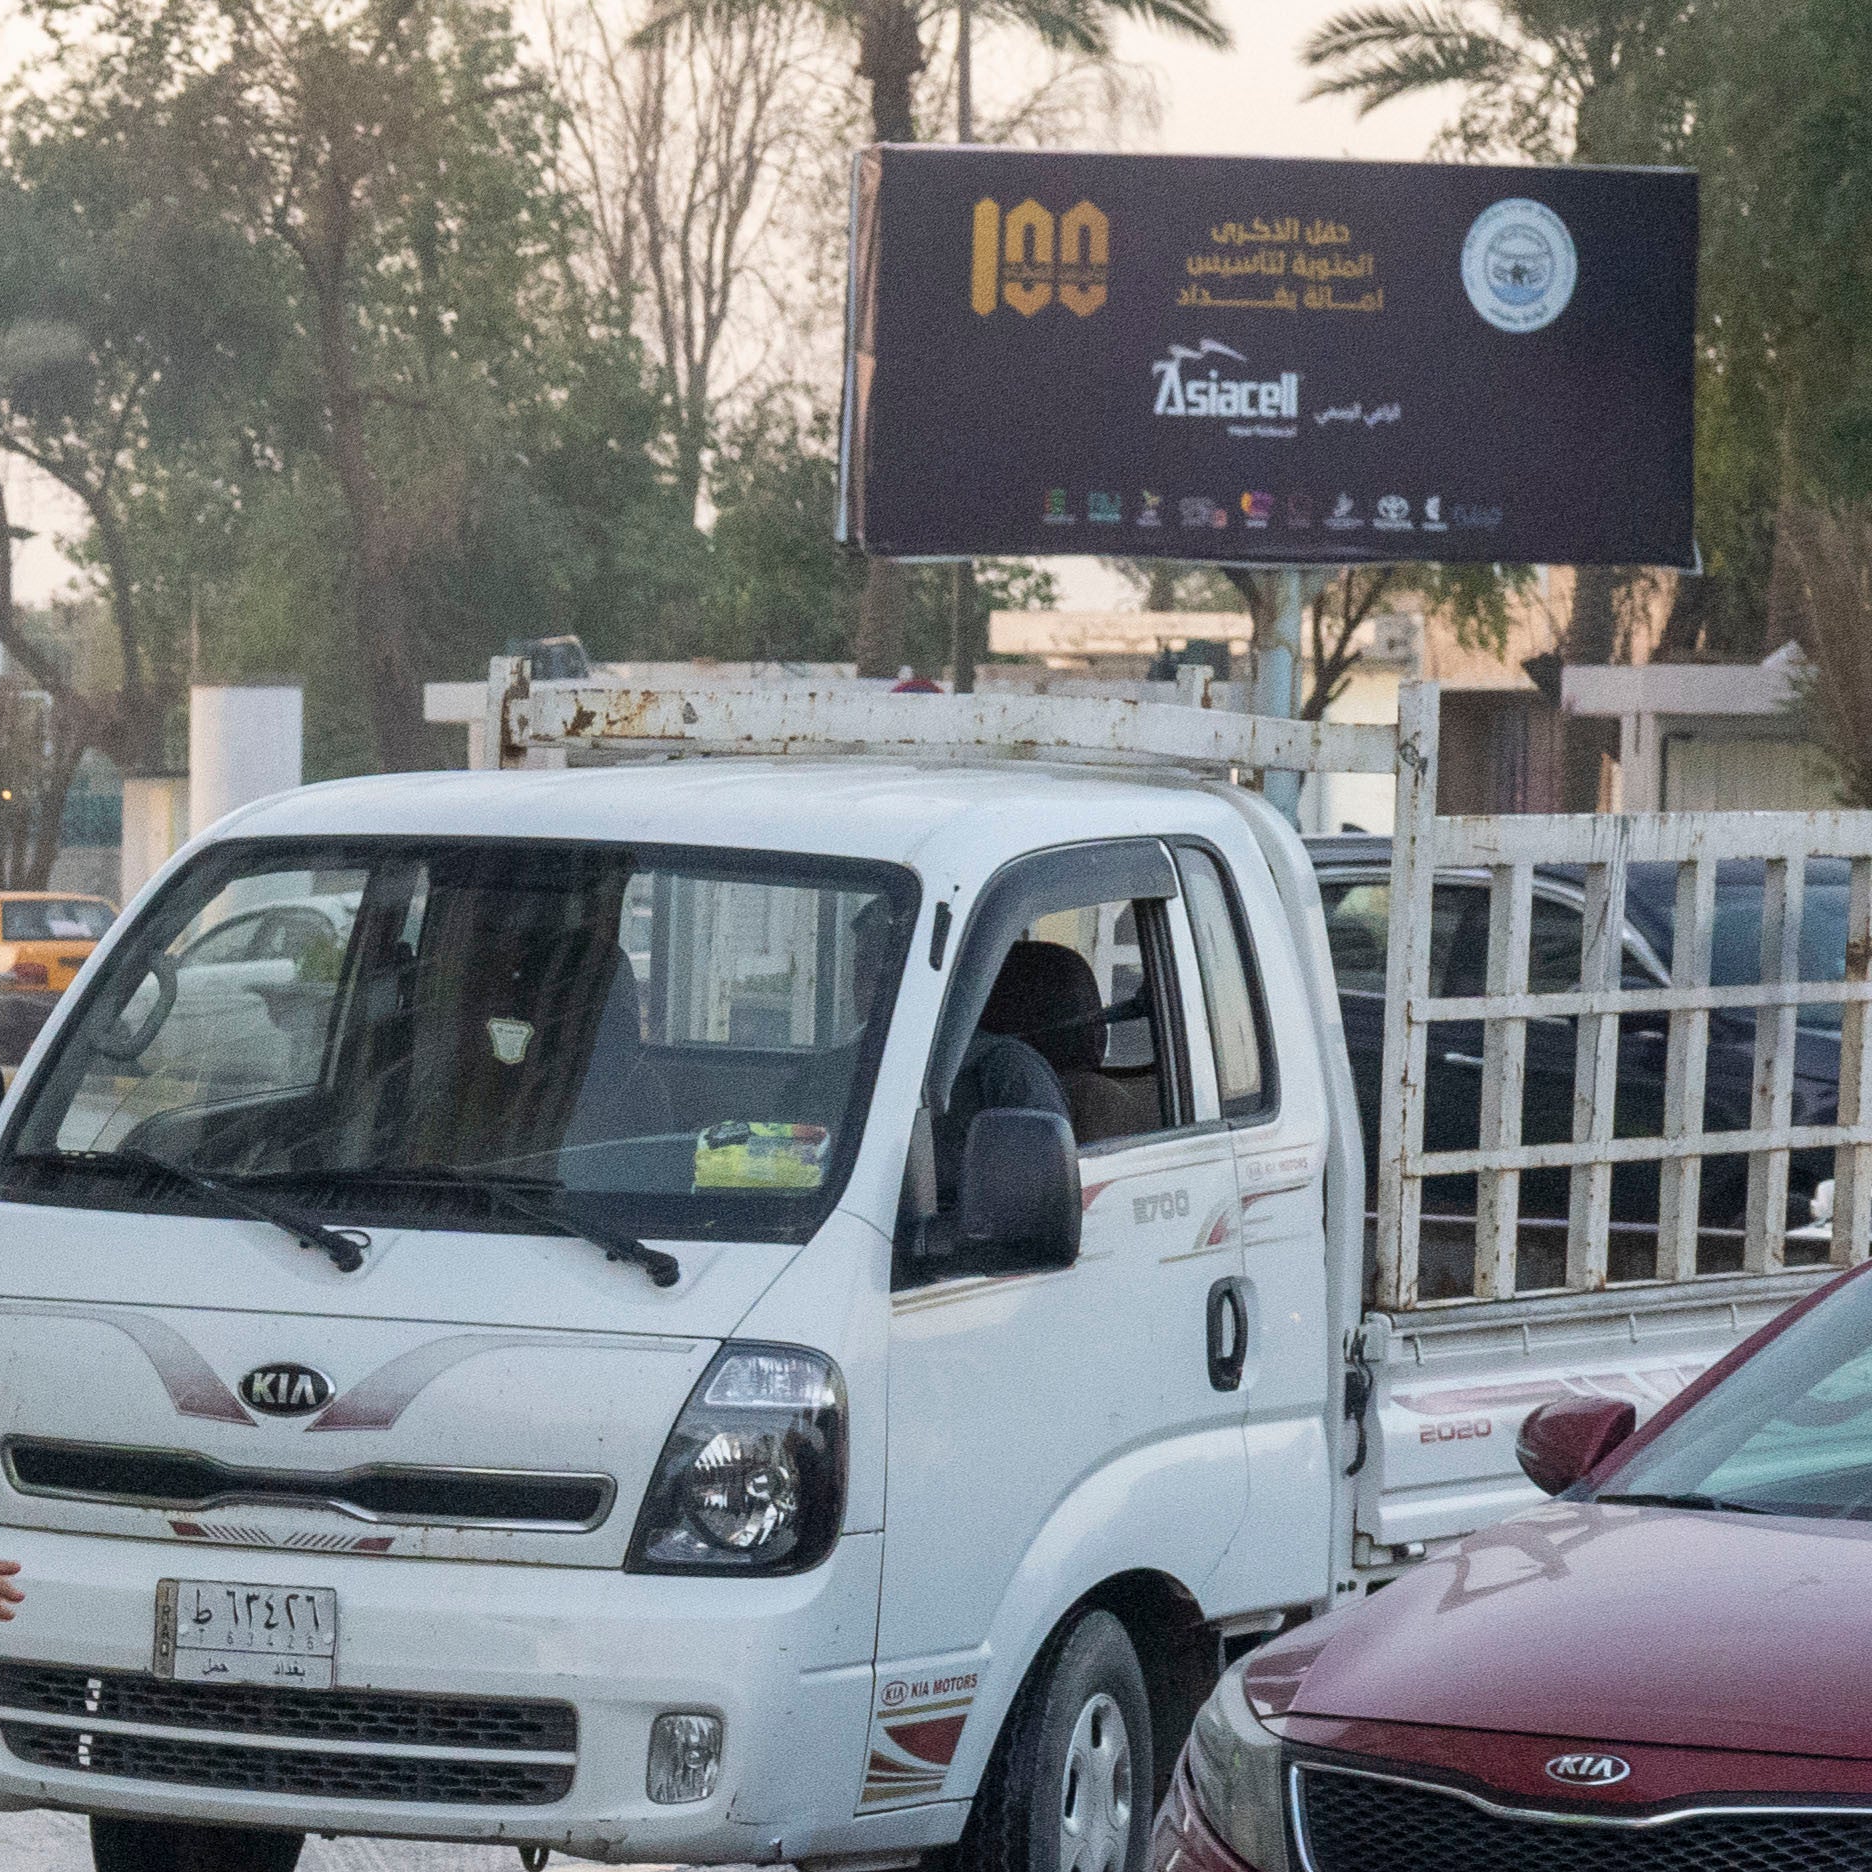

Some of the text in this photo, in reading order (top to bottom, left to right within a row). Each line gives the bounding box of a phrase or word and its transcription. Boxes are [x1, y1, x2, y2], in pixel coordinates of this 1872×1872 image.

[1152, 356, 1299, 419] Asiacell
[252, 1372, 316, 1405] KIA
[274, 1660, 306, 1683] بغداد
[933, 1673, 978, 1695] MOTORS
[1557, 1756, 1613, 1778] KIA
